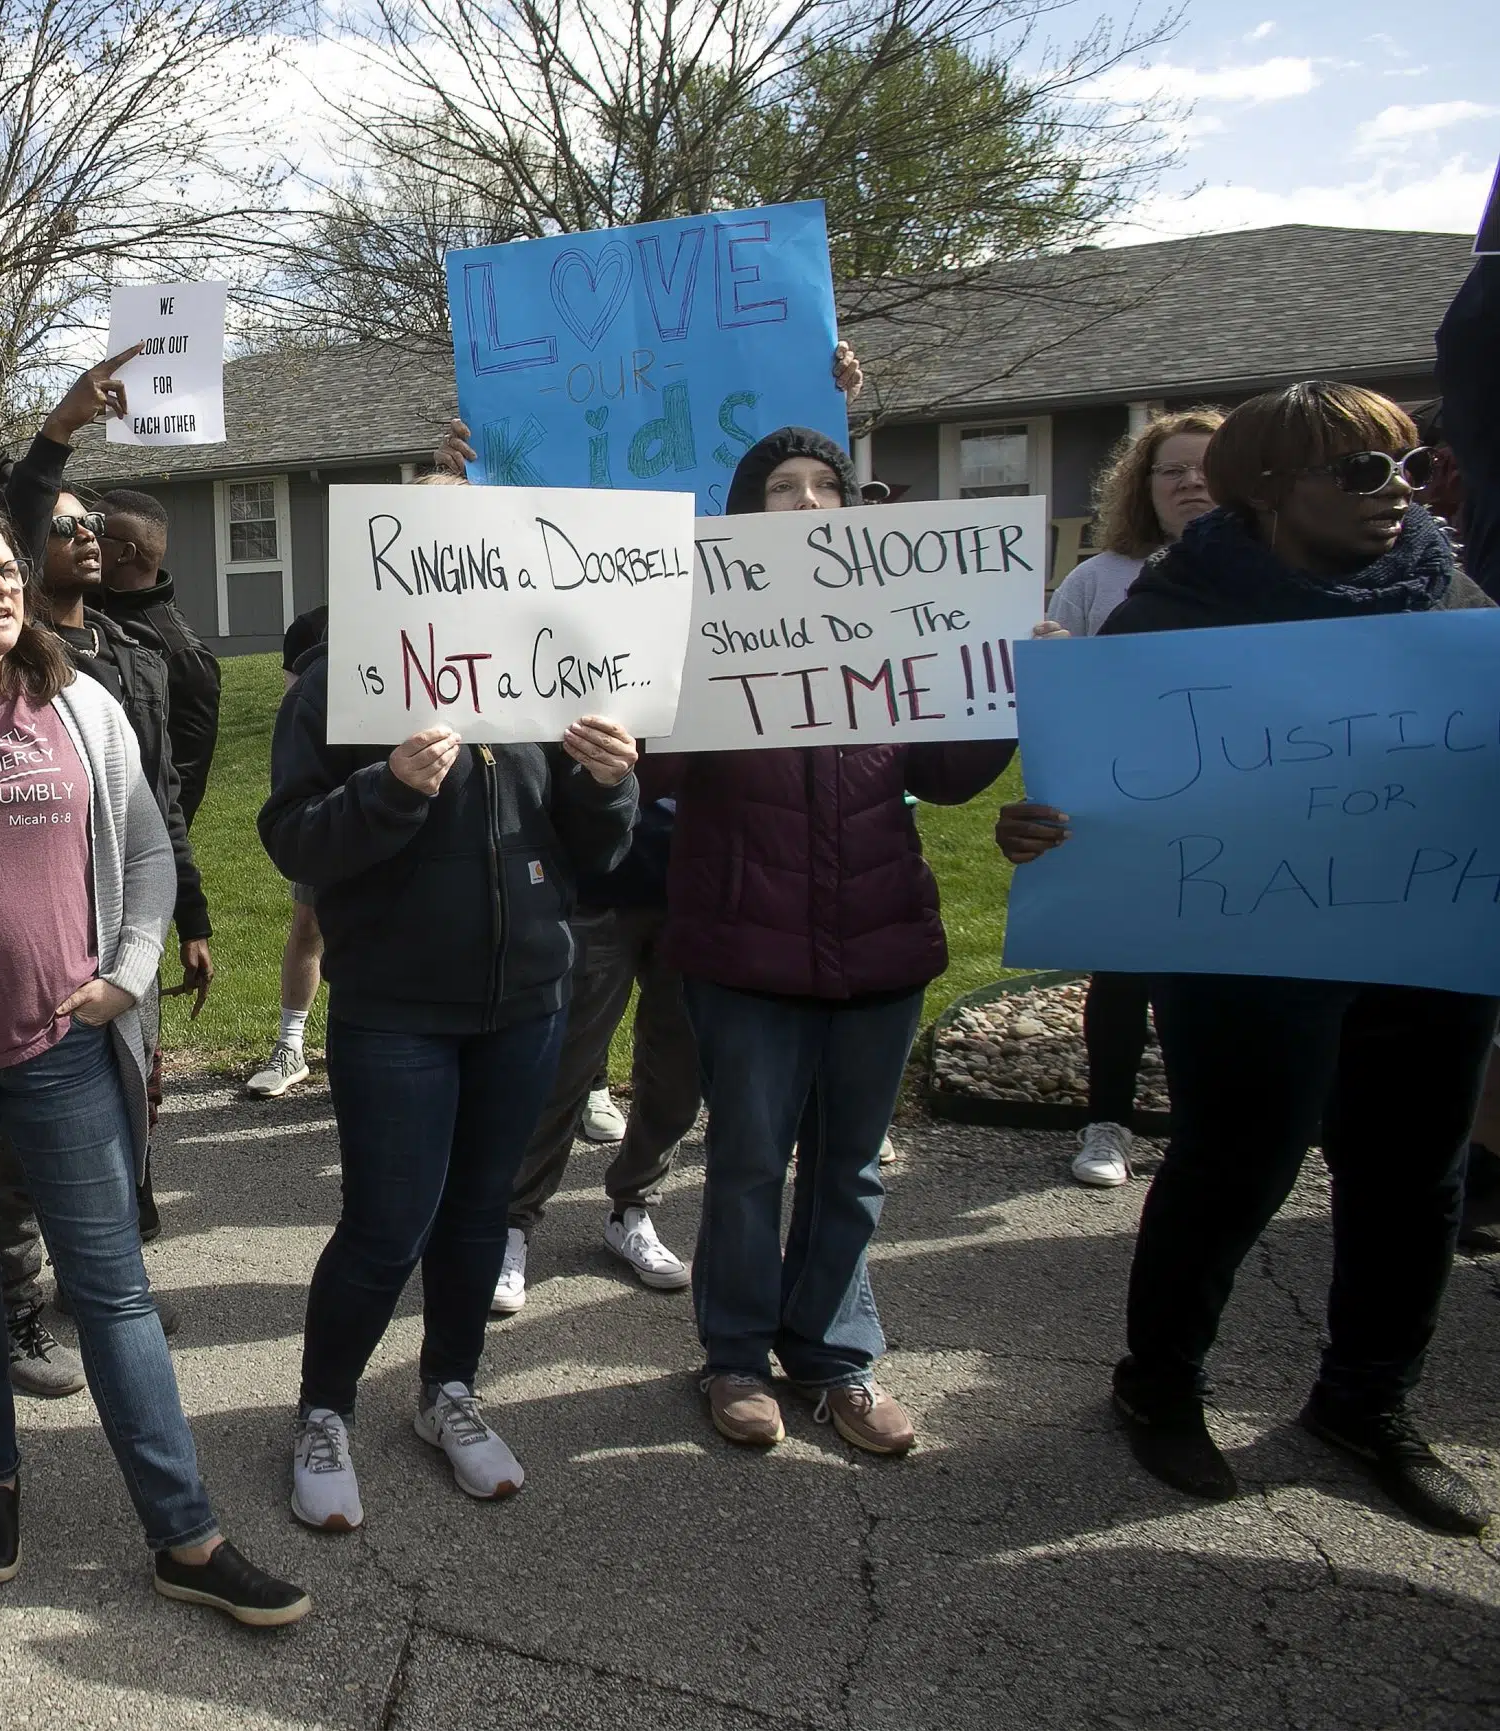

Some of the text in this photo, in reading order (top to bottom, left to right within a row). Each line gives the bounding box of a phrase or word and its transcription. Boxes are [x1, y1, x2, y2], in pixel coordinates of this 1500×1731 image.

[160, 297, 174, 316] WE
[169, 335, 188, 354] OUT
[153, 376, 173, 395] FOR
[133, 414, 196, 435] EACH OTHER
[694, 523, 1034, 595] The SHOOTER
[518, 568, 537, 590] a
[701, 601, 971, 655] Should Do The
[400, 622, 493, 714] NOT
[497, 672, 522, 699] a
[1111, 684, 1500, 801] JUSTIC
[1307, 783, 1416, 821] FOR
[9, 812, 72, 826] Micah 6:8
